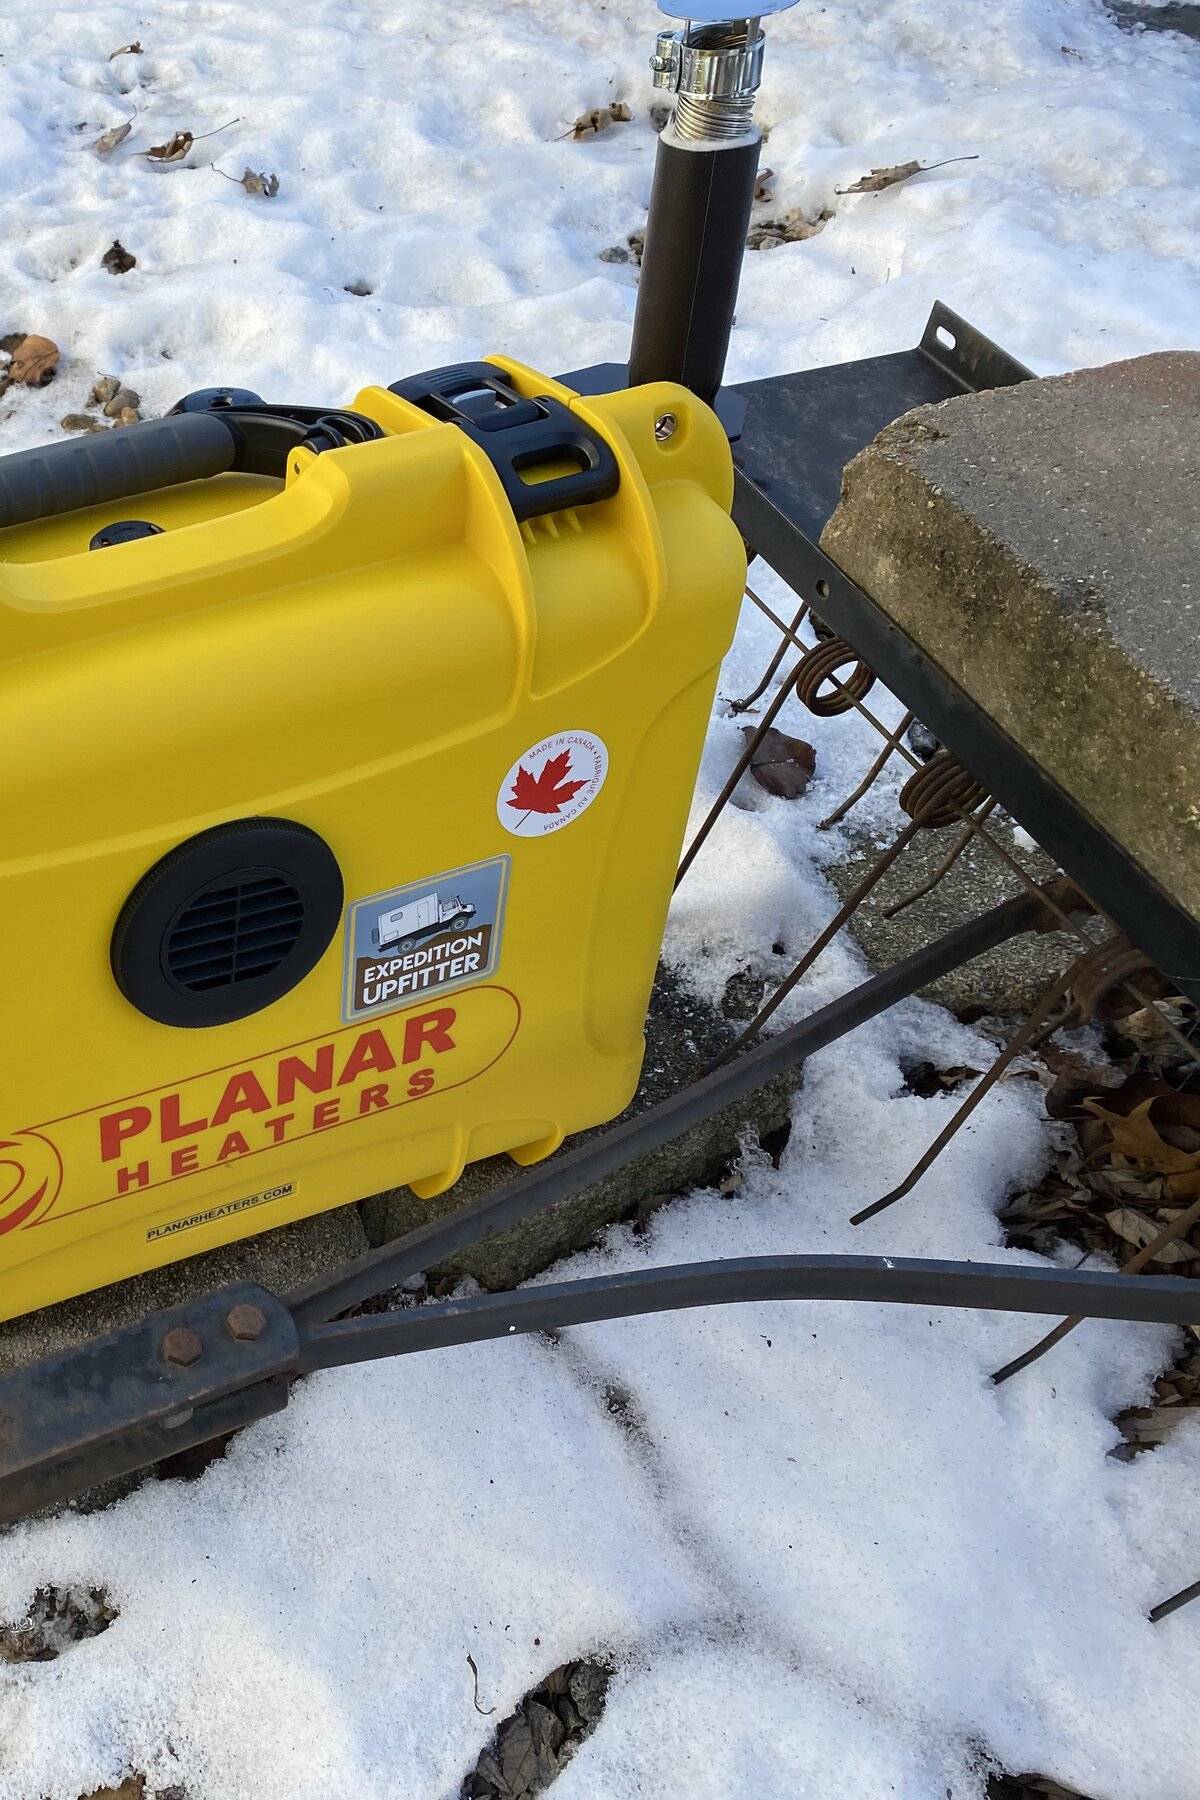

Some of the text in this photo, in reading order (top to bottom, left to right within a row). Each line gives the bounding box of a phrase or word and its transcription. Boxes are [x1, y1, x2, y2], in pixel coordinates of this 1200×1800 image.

[529, 736, 595, 760] MADE IN CANADA
[543, 755, 601, 831] FABRIQUE AU CANADA
[363, 952, 481, 1005] UPFITTER
[364, 931, 483, 984] EXPEDITION
[100, 1007, 457, 1163] PLANAR
[116, 1068, 435, 1193] HEATERS
[146, 1184, 293, 1240] PLANARHEATERS.COM
